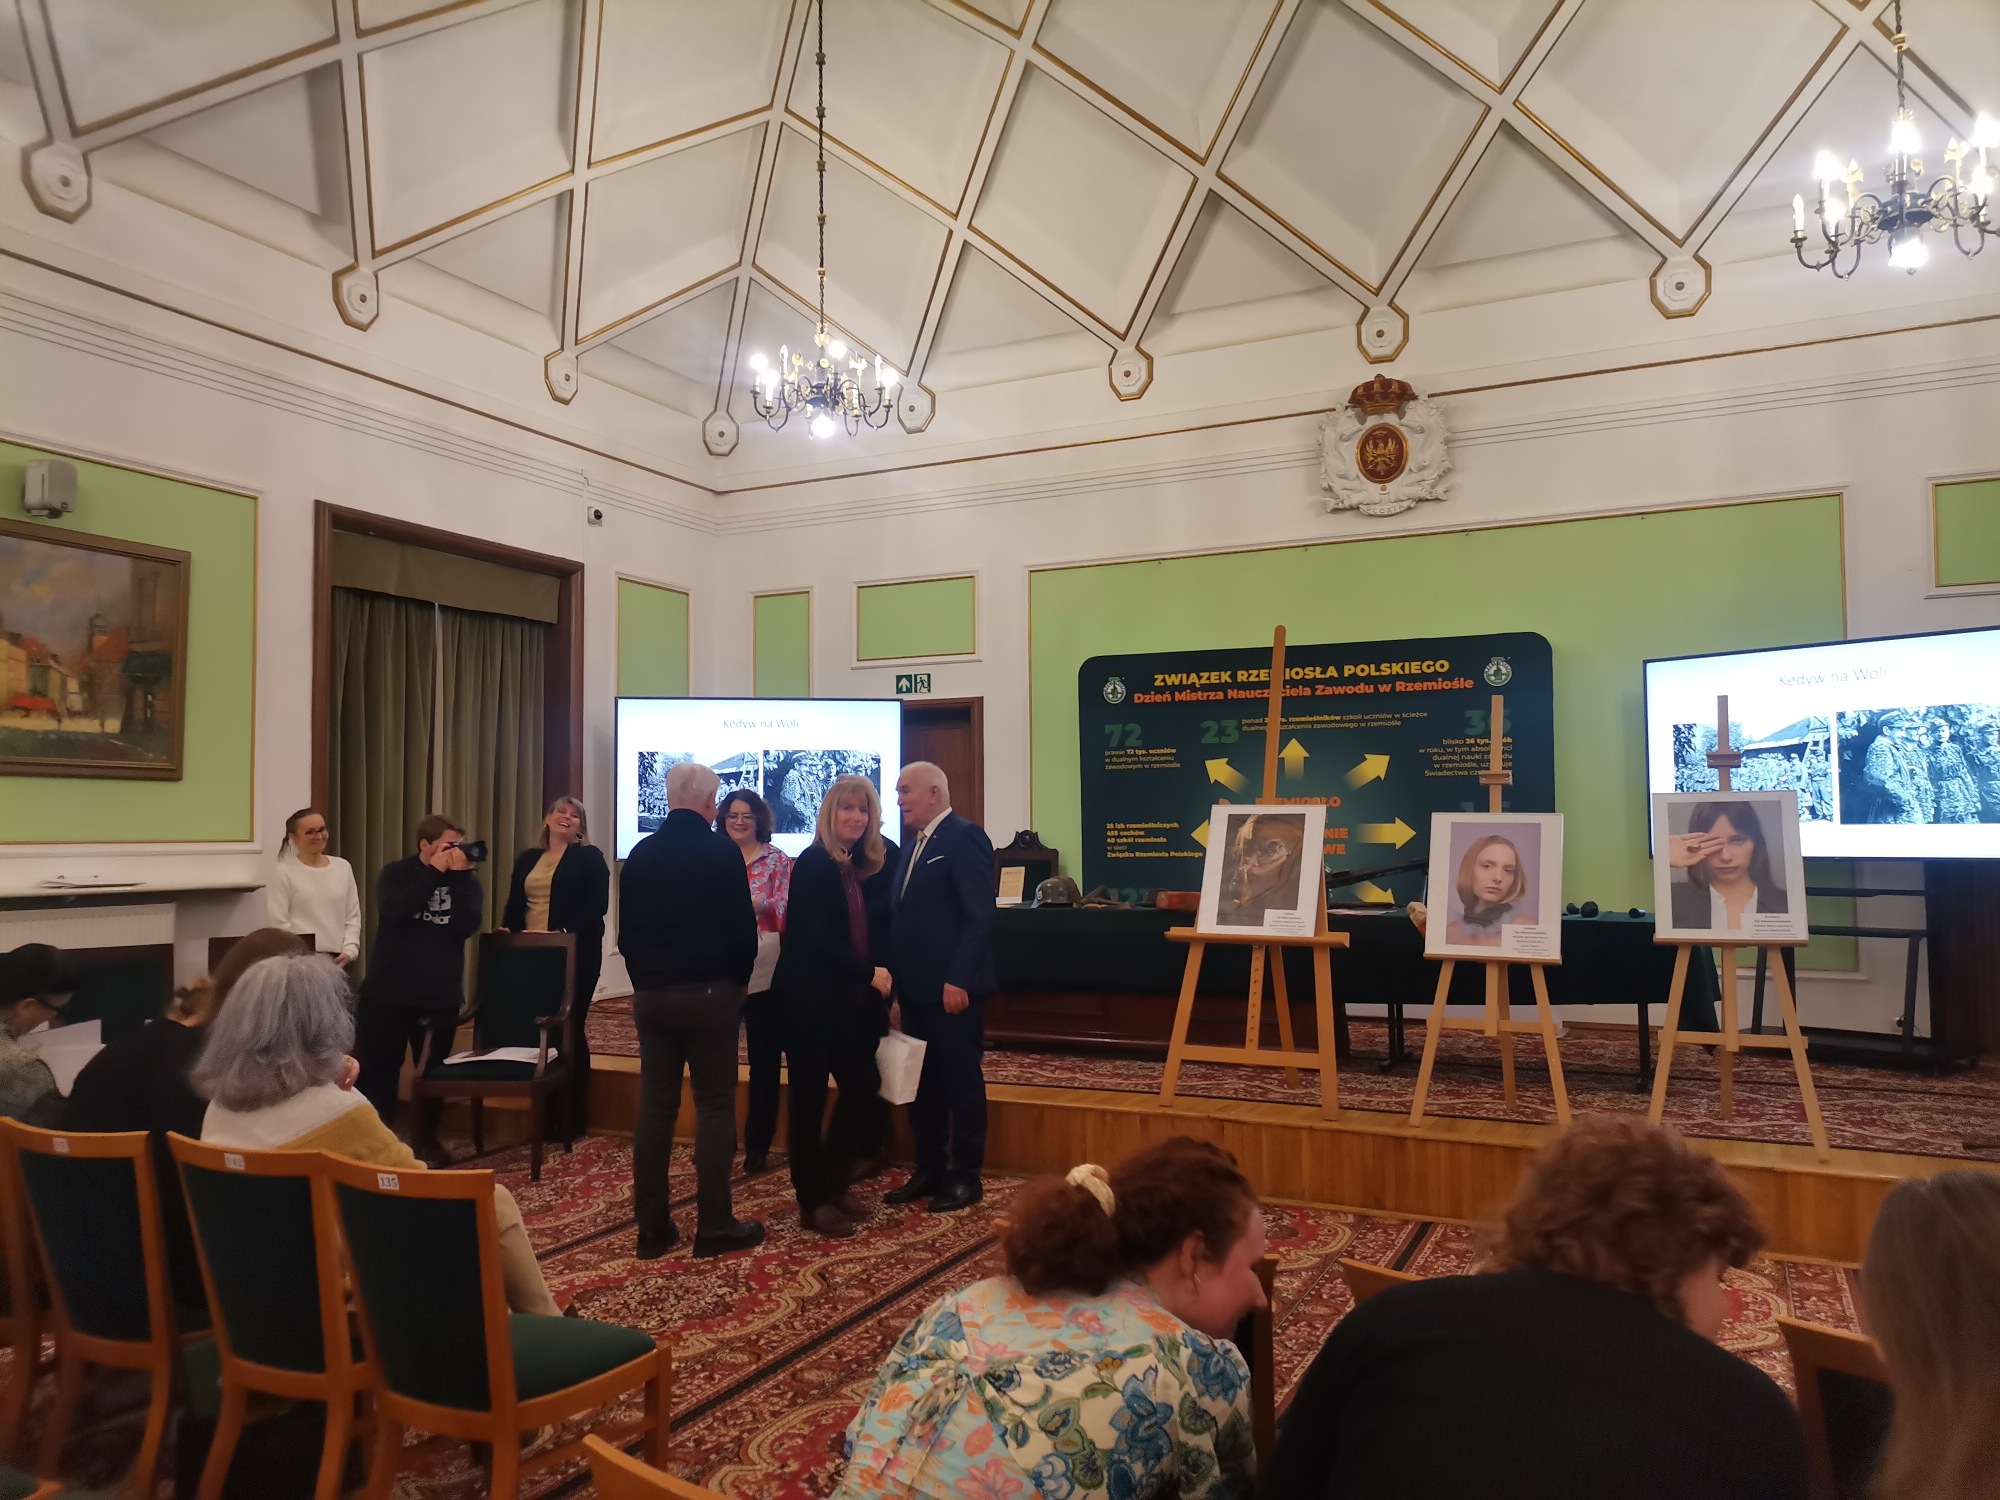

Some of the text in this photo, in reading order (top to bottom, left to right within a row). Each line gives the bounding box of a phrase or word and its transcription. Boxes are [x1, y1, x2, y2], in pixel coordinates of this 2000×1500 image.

[1154, 659, 1450, 688] ZWIĄZEK RZEIOSŁA POLSKIEGO
[1779, 666, 1887, 687] Kedyw na Woli
[1134, 677, 1475, 704] Dzień Mistrza Nauczciela Zawodu w Rzemiośle
[723, 718, 799, 730] Kedyw na Woli
[1242, 717, 1263, 725] ponad
[1289, 714, 1342, 723] rzemieślników
[1343, 713, 1362, 721] szkoli
[1364, 712, 1392, 720] uczniów
[1313, 721, 1358, 729] zawodowego
[1367, 720, 1402, 728] rzemiośle
[1104, 723, 1142, 747] 72
[1200, 719, 1240, 744] 23
[1425, 769, 1468, 777] Świadectwa
